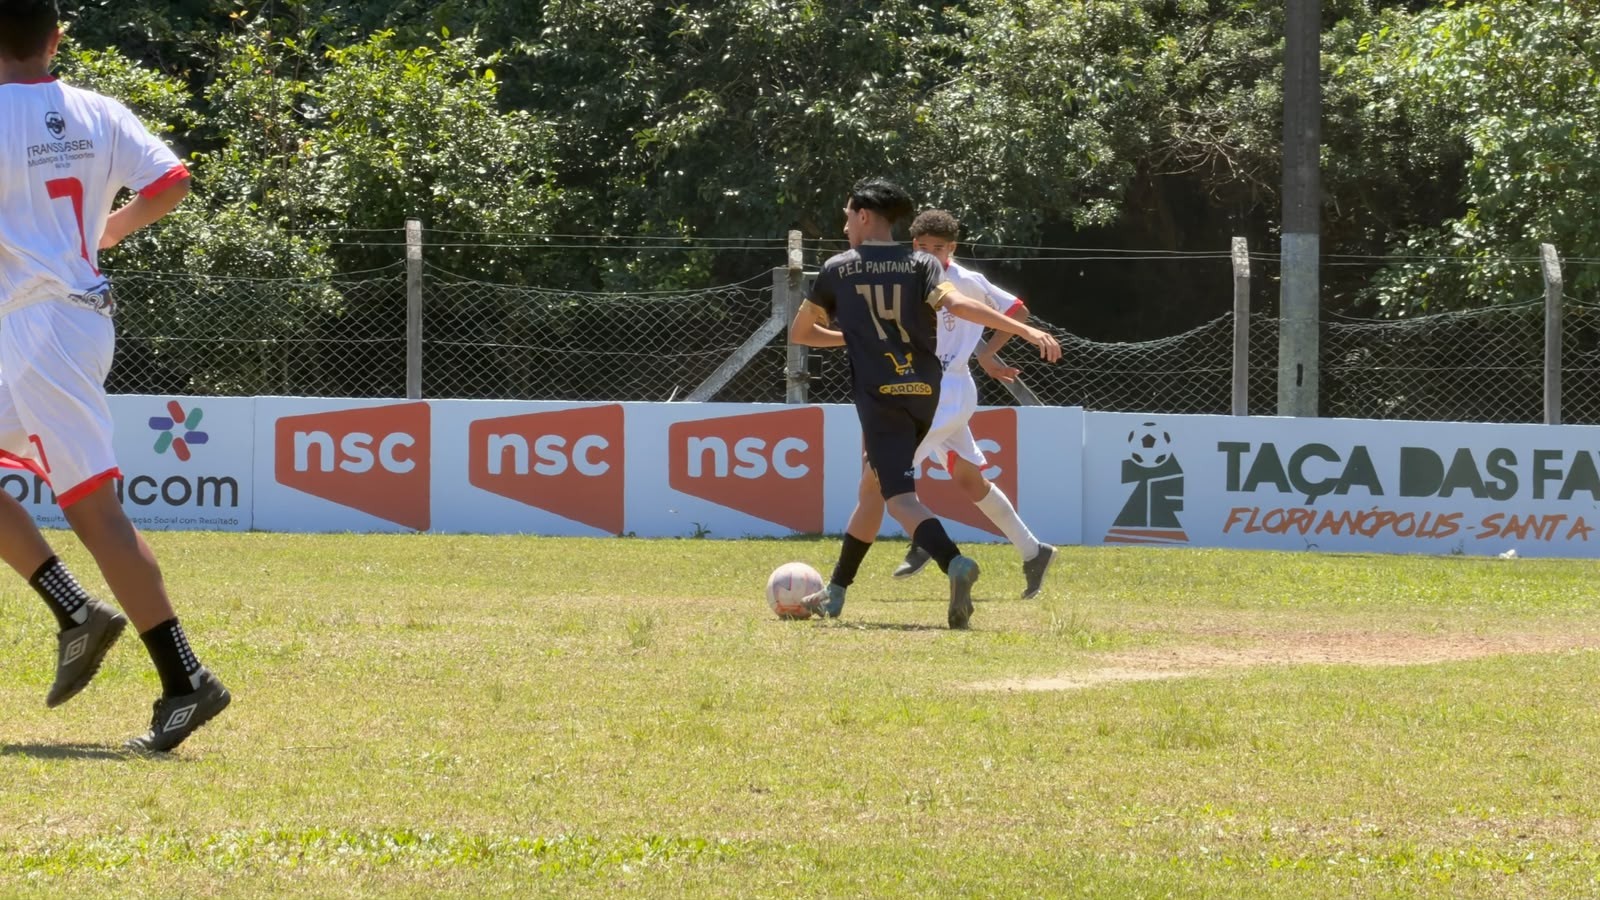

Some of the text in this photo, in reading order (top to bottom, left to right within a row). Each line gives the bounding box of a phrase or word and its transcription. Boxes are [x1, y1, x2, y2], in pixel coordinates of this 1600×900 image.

[45, 176, 101, 278] 7
[866, 260, 917, 274] PANTANAL
[855, 284, 911, 343] 14
[294, 430, 416, 474] nsc
[487, 433, 610, 477] nsc
[687, 436, 810, 479] nsc
[1217, 441, 1600, 506] TAÇA DAS FA
